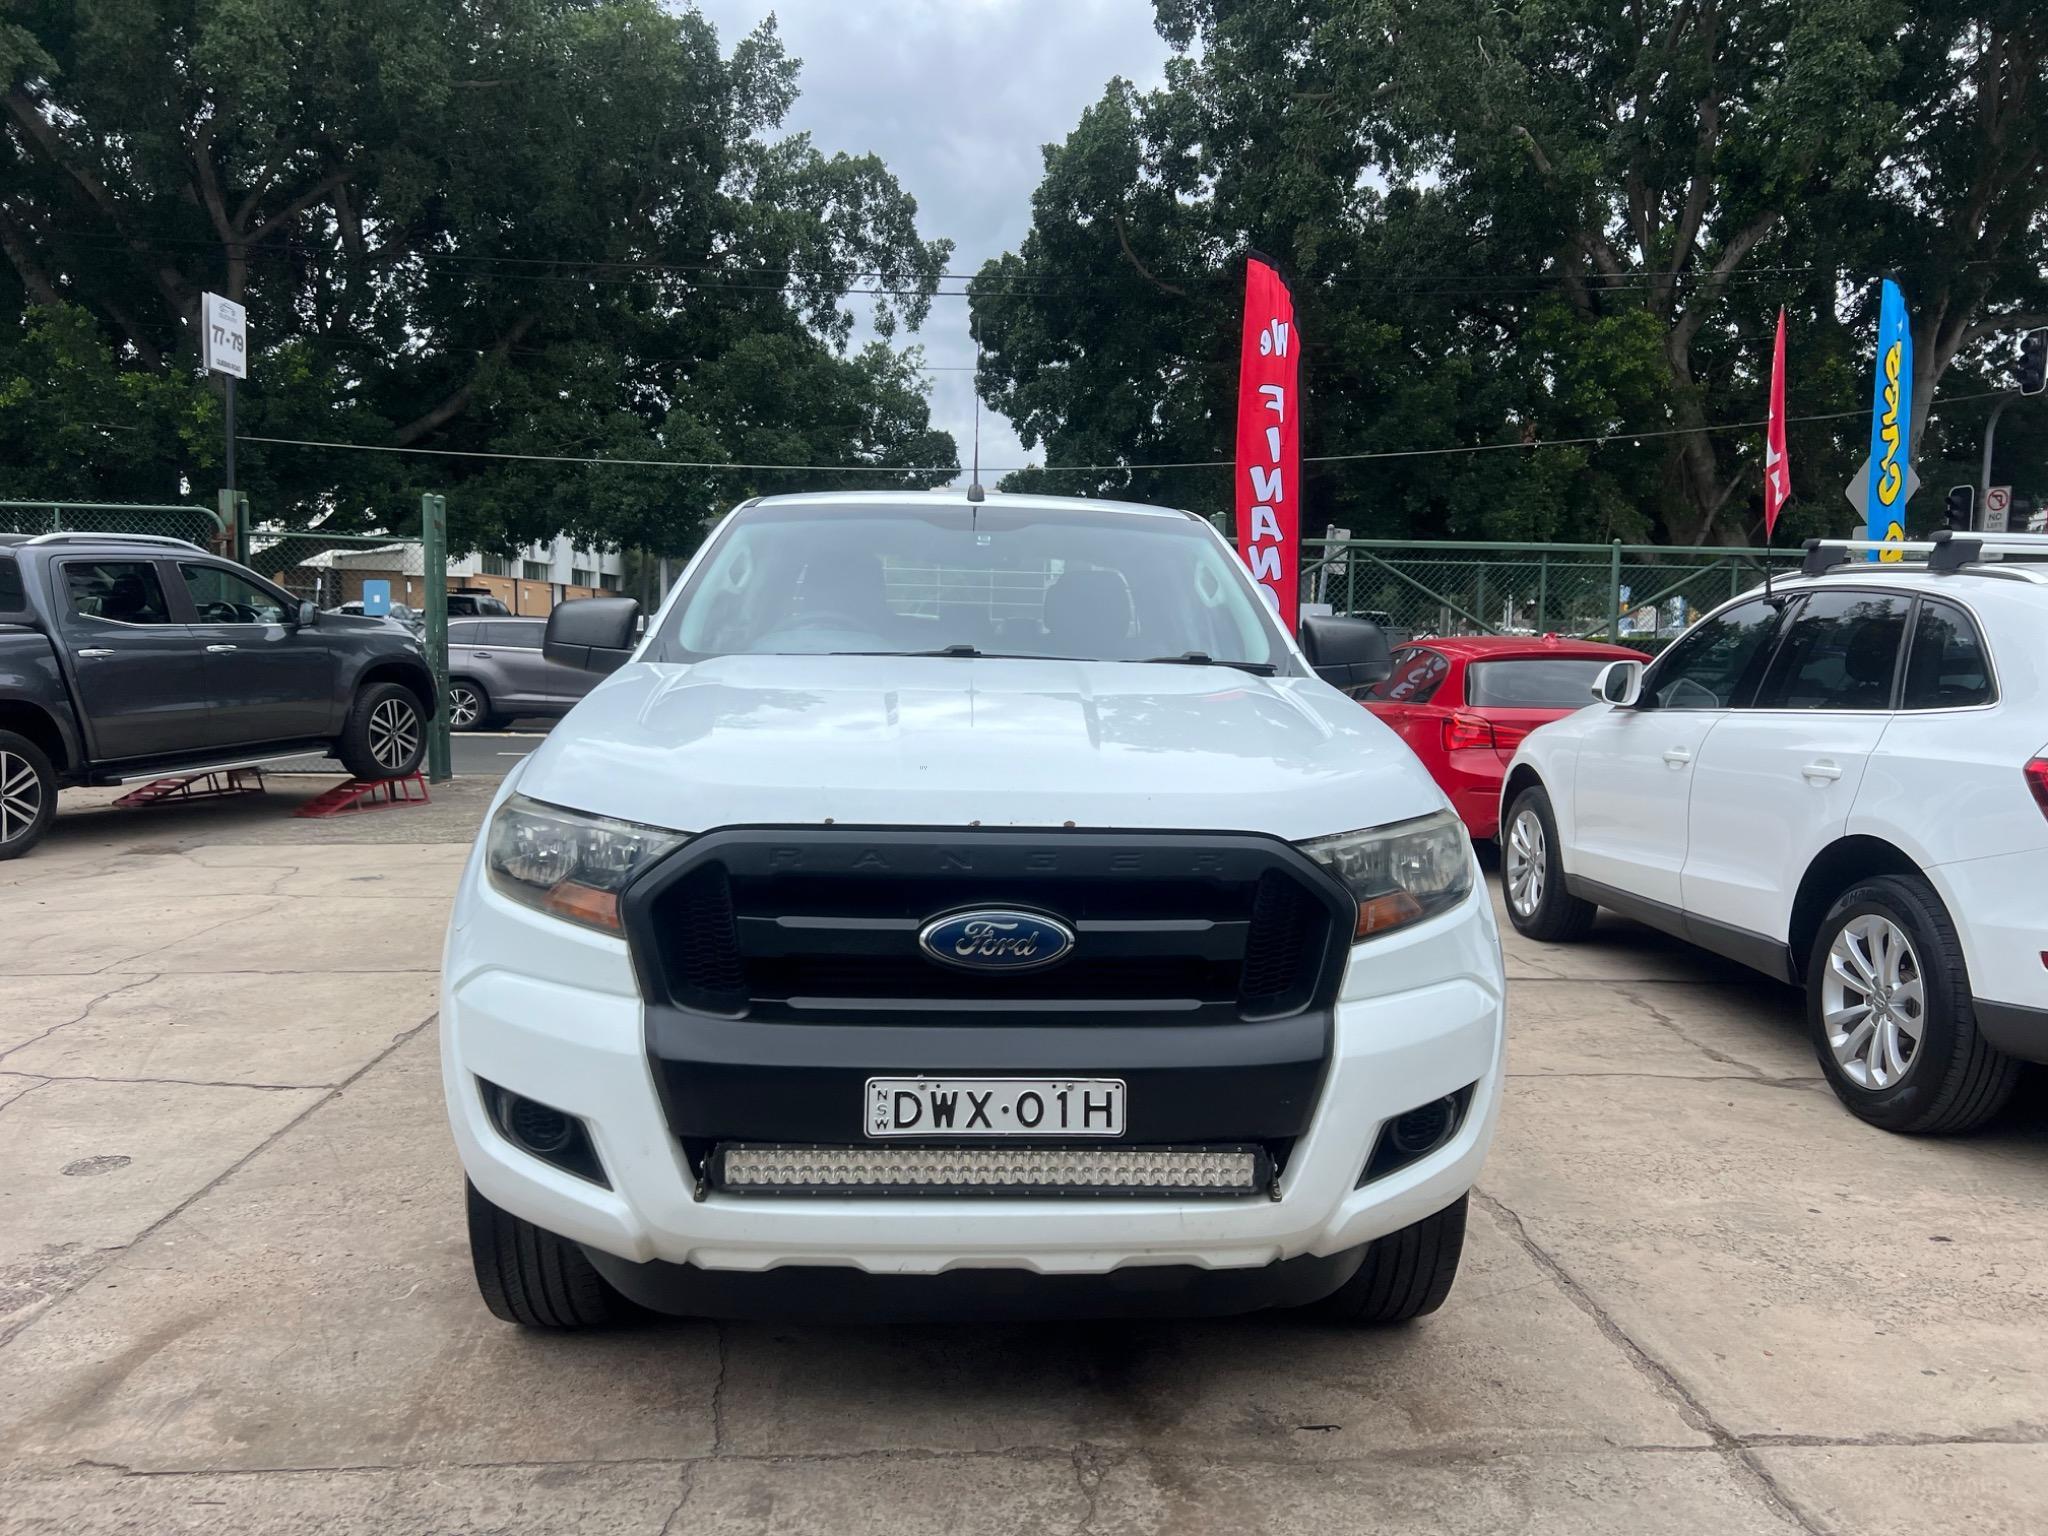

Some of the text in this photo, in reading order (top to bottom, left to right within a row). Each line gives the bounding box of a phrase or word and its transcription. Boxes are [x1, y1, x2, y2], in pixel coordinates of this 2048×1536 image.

[1988, 512, 2002, 521] NO
[768, 847, 1227, 873] RANGER
[954, 920, 1039, 956] Ford
[874, 1089, 890, 1131] NSW
